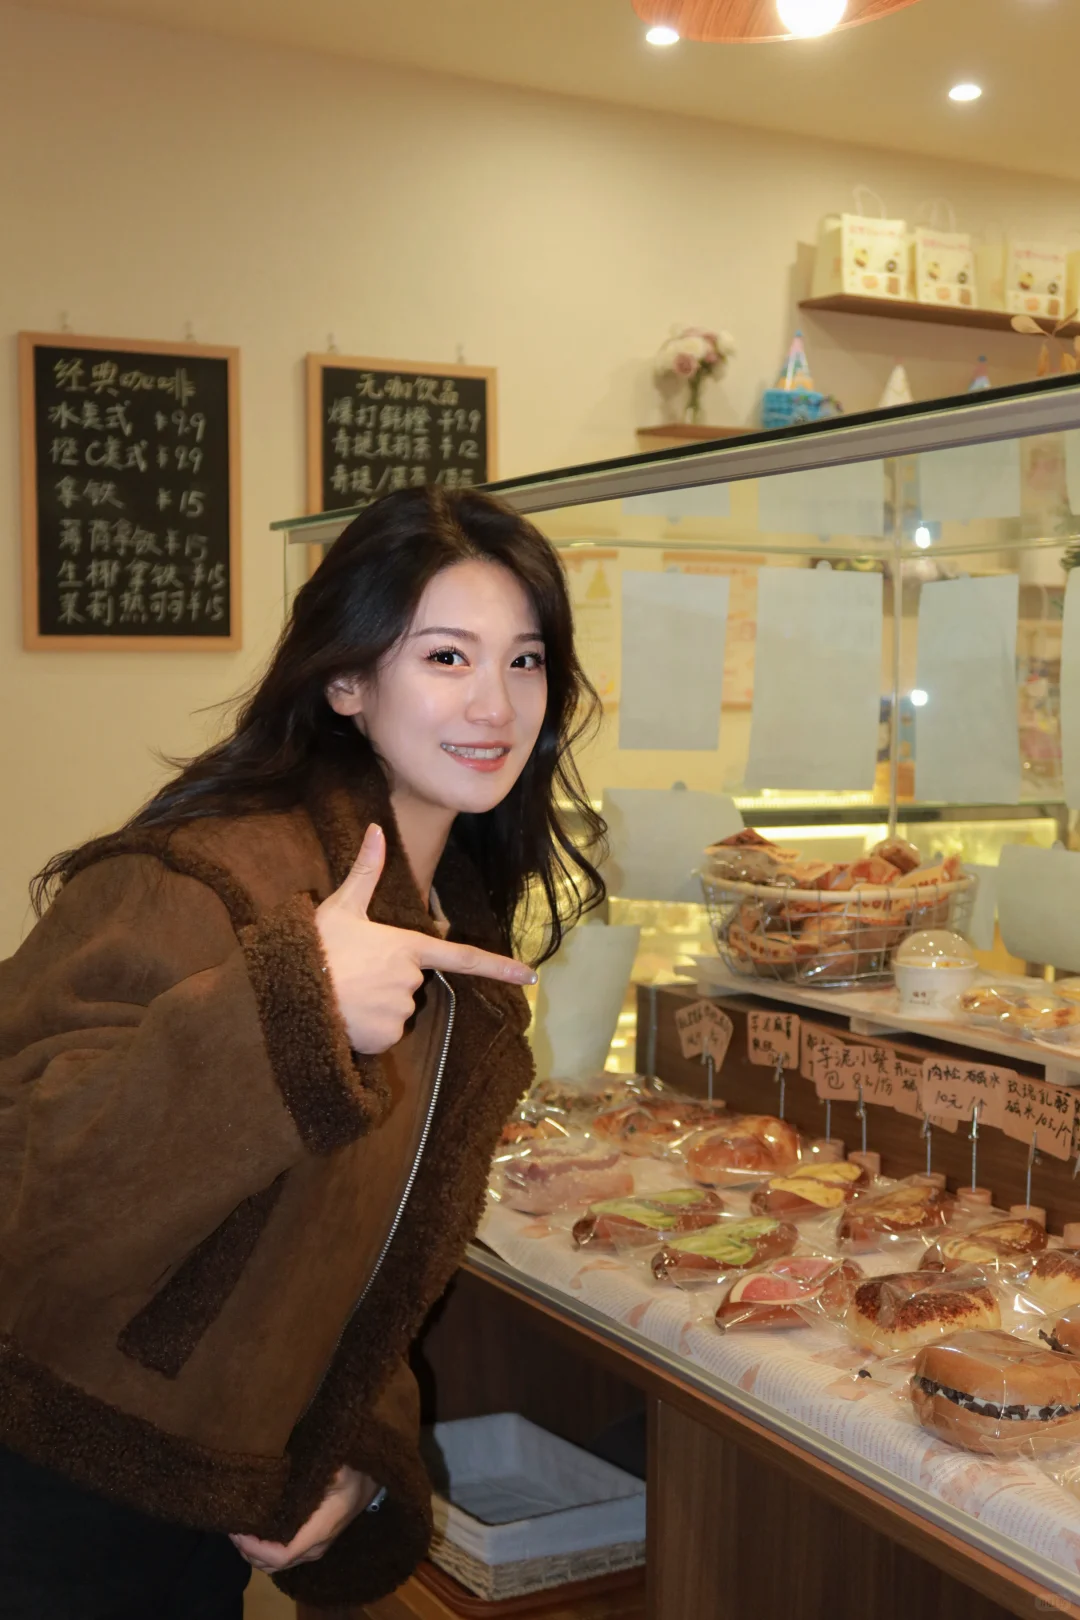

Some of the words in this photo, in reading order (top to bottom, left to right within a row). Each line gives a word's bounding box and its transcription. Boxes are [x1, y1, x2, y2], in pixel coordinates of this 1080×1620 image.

[53, 357, 197, 408] 经典咖啡
[355, 373, 459, 406] 无咖饮品
[48, 400, 133, 437] 冰美式
[54, 476, 126, 510] 拿铁
[56, 558, 185, 592] 生椰拿铁
